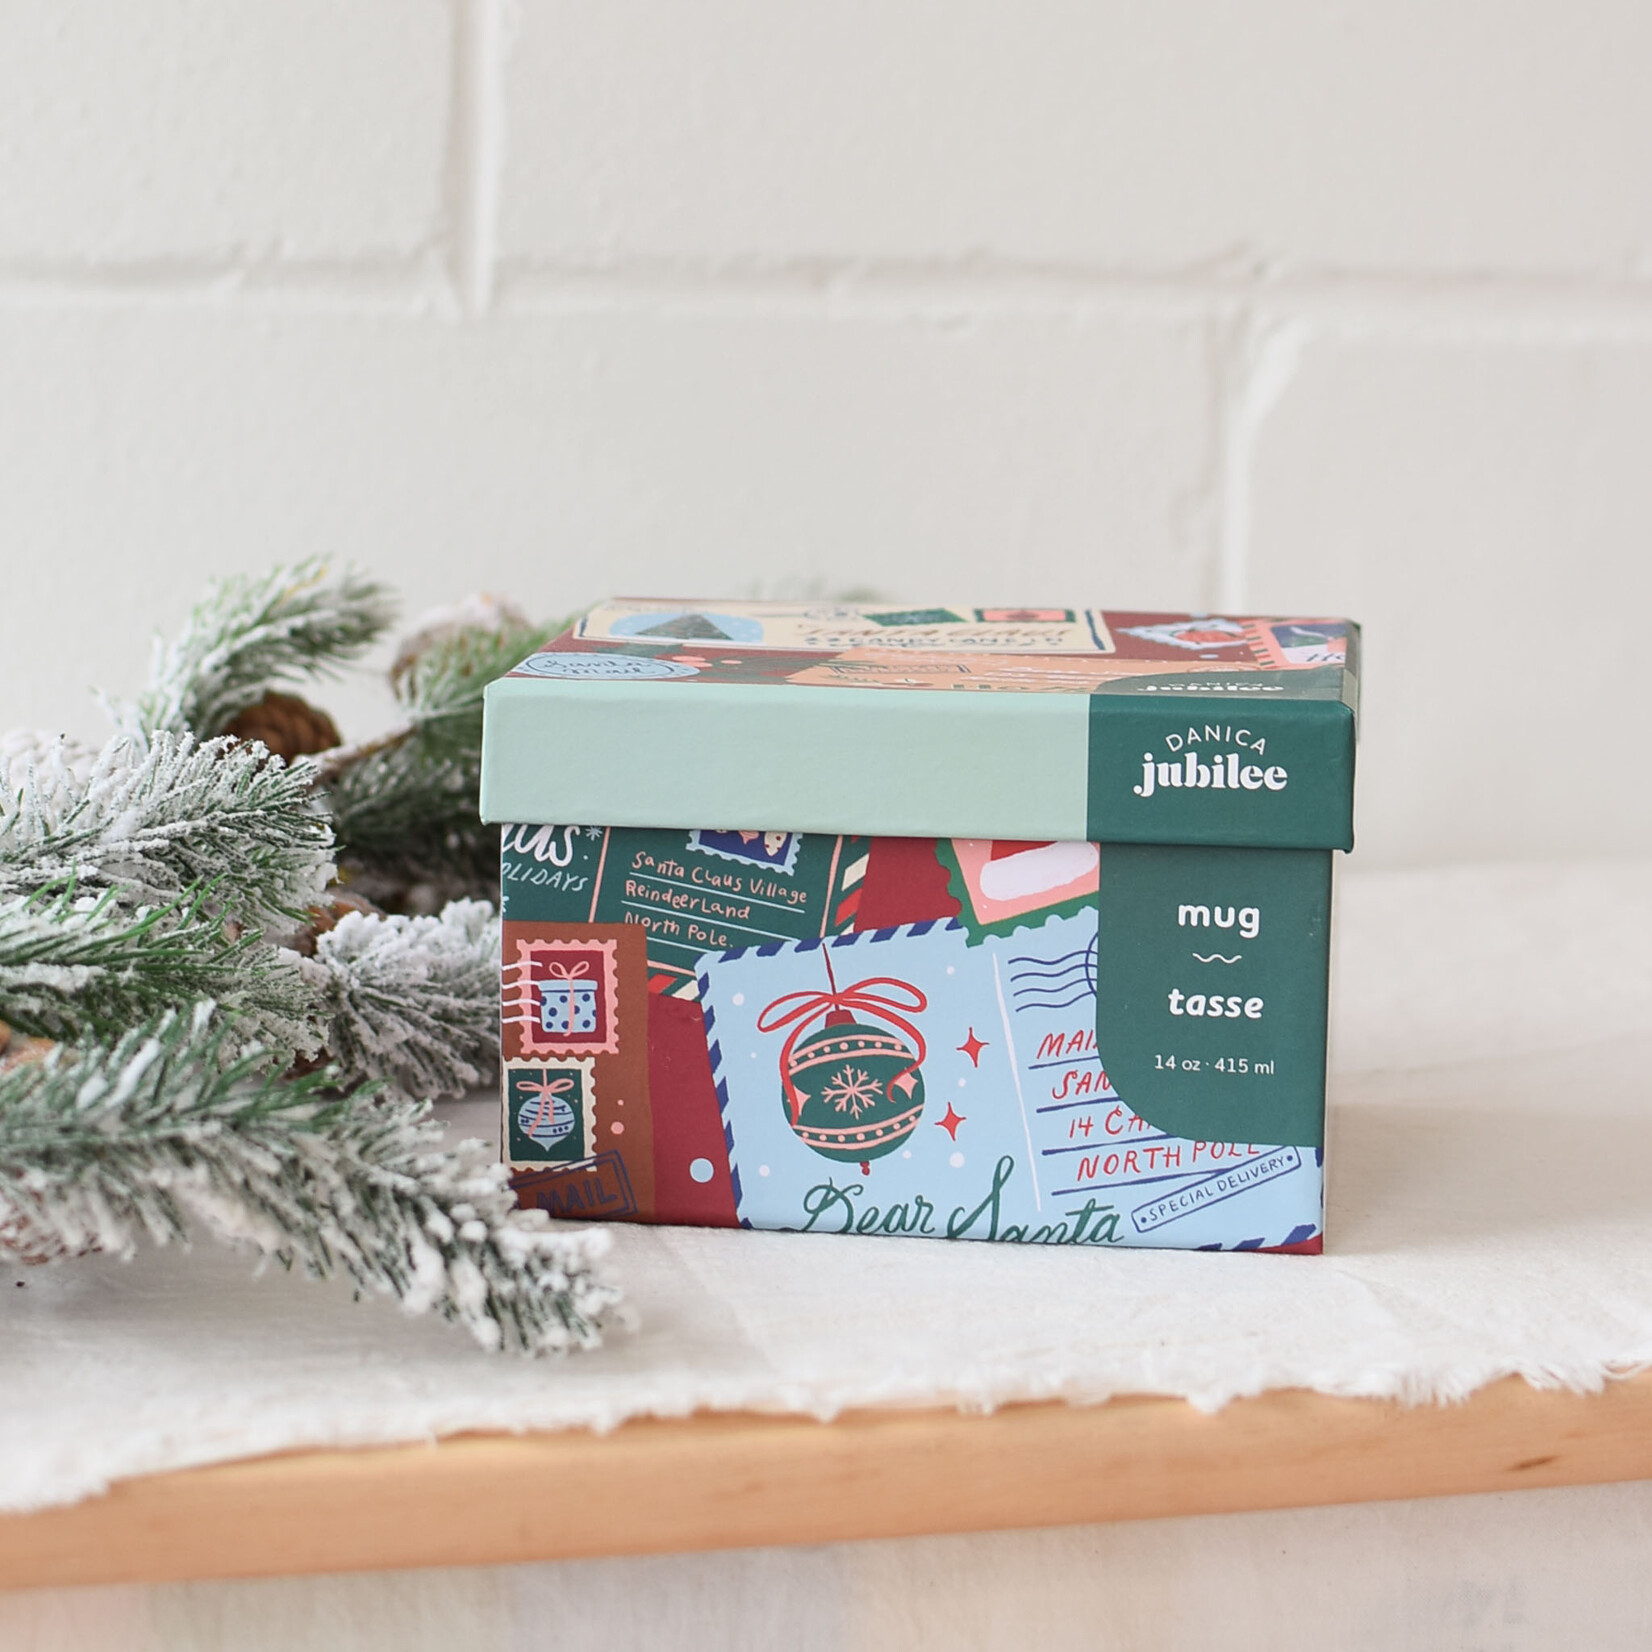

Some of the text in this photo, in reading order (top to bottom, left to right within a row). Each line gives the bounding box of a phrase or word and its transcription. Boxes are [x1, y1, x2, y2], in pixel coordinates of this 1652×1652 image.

[1165, 724, 1267, 756] DANICA
[1133, 752, 1288, 798] jubilee
[631, 850, 685, 878] Santa
[749, 878, 807, 905] Village
[624, 911, 734, 948] North Pole.
[1177, 904, 1260, 939] mug
[1167, 988, 1264, 1019] tasse
[1036, 1029, 1098, 1060] MAI
[1154, 1054, 1275, 1075] 14 oz 415 ml
[1069, 1115, 1094, 1138] 14
[1077, 1145, 1181, 1182] NORTH
[536, 1176, 618, 1216] MAIL
[803, 1155, 1125, 1245] Dear Santa
[1149, 1155, 1285, 1222] SPECIAL DELIVERY
